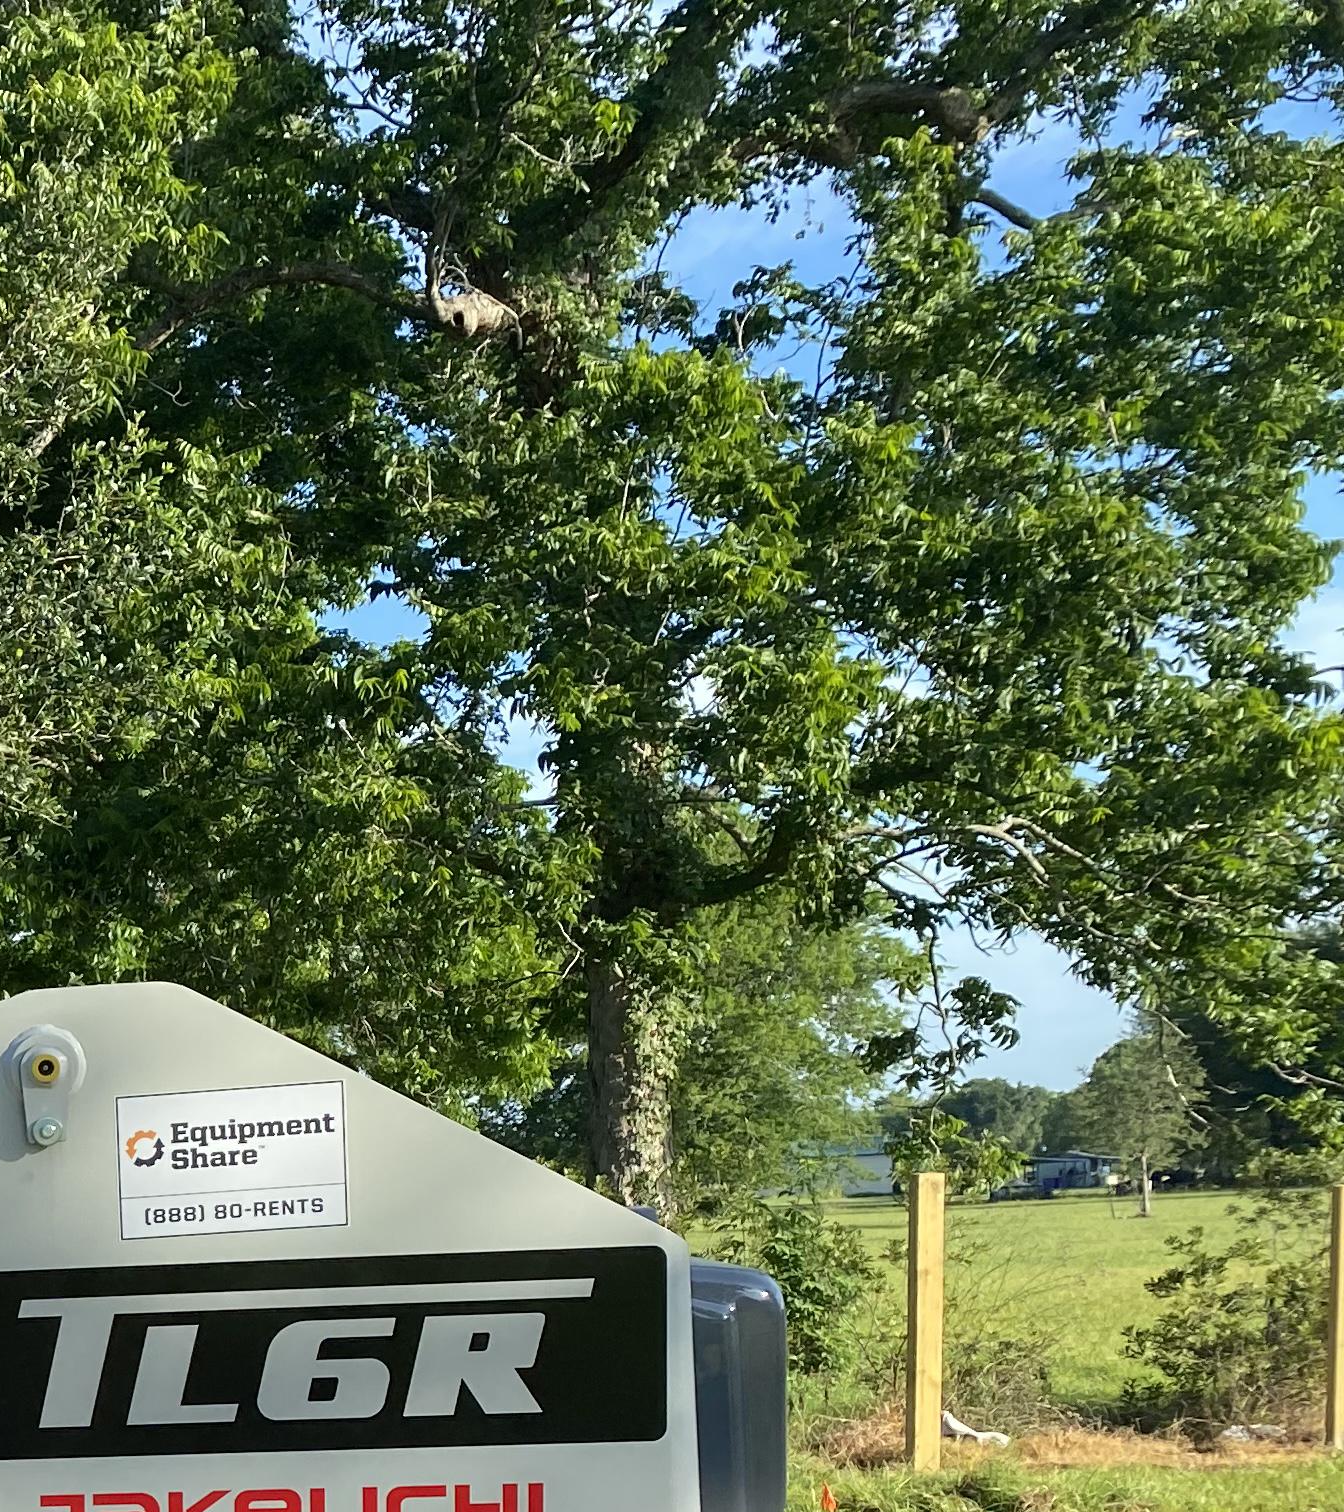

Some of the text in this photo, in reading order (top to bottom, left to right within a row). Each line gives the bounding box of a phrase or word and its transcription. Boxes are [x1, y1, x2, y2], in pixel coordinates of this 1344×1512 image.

[170, 1113, 335, 1147] Equipment
[171, 1148, 258, 1169] Share
[144, 1198, 324, 1225] (888) 80-RENTS
[18, 1278, 595, 1428] TL6R
